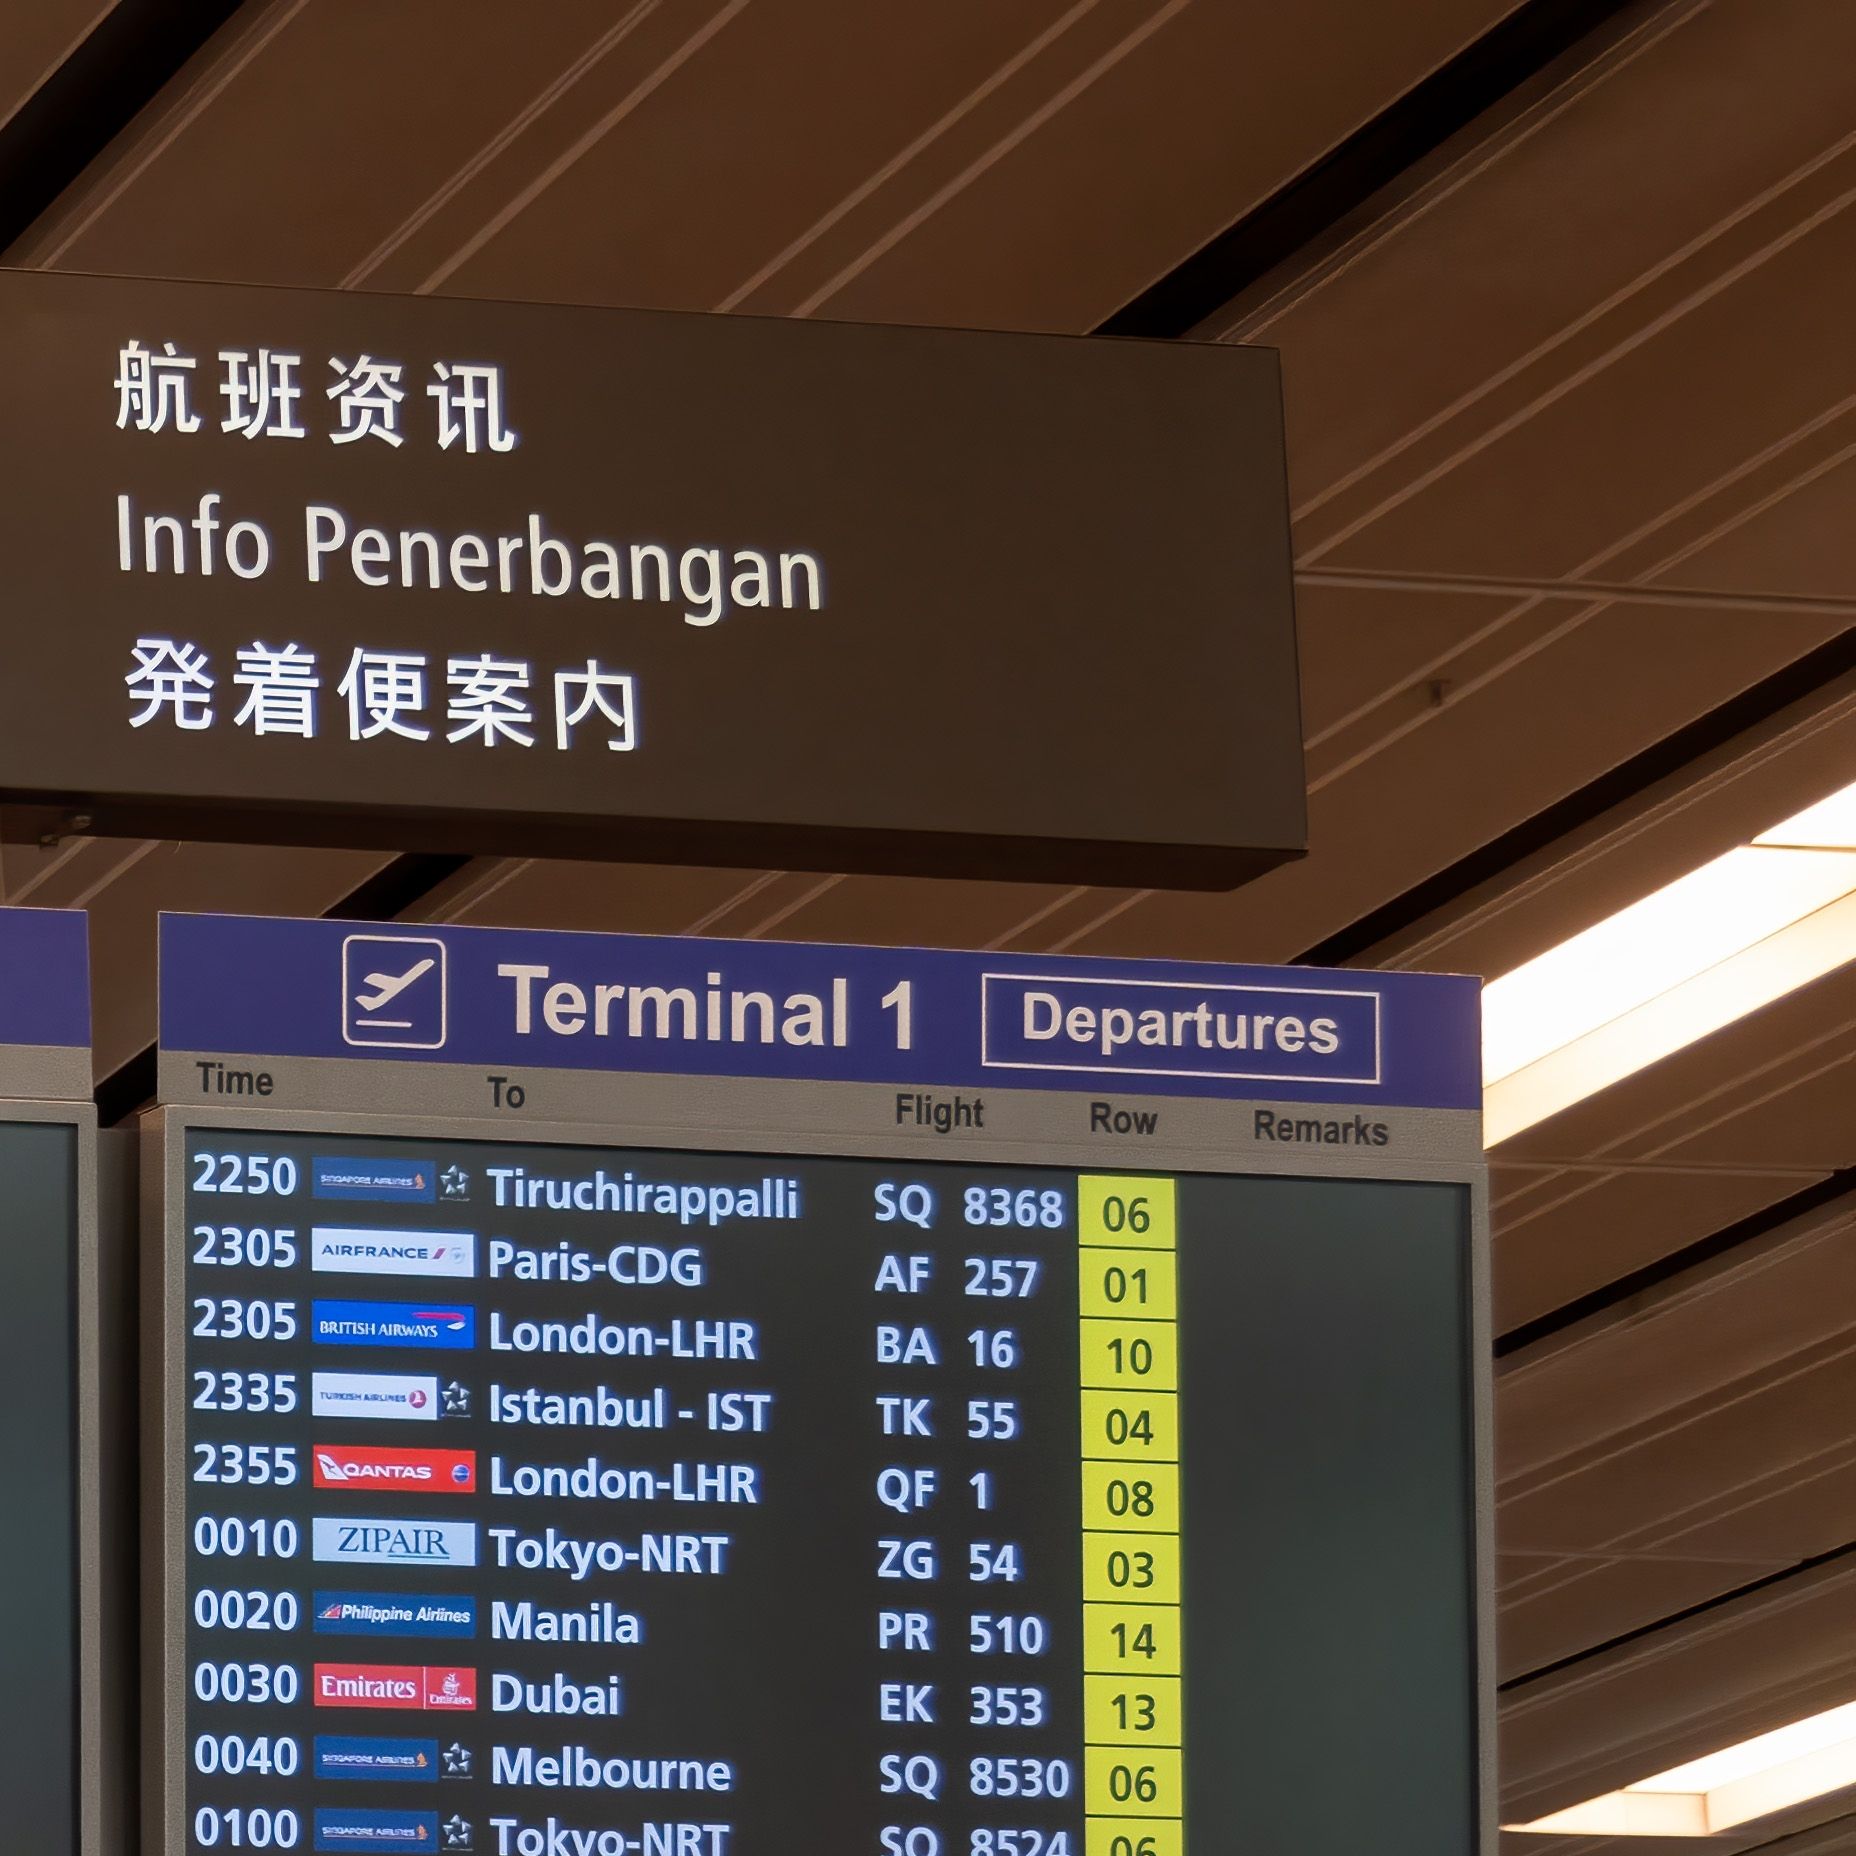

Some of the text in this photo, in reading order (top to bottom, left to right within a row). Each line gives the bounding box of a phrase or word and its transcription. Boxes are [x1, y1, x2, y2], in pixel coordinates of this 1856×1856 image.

[114, 340, 515, 453] 航班资讯
[118, 494, 819, 626] Info Penerbangan
[125, 639, 634, 751] 発着便案内
[498, 964, 1338, 1055] Terminal 1 Departures
[196, 1062, 1389, 1146] Time To Flight Row Remarks
[194, 1226, 1146, 1303] 2305 AIRFRANCE Paris-CDG AF 257 01
[195, 1517, 1153, 1588] 0010 ZIPAIR Tokyo-NRT ZG 54 03
